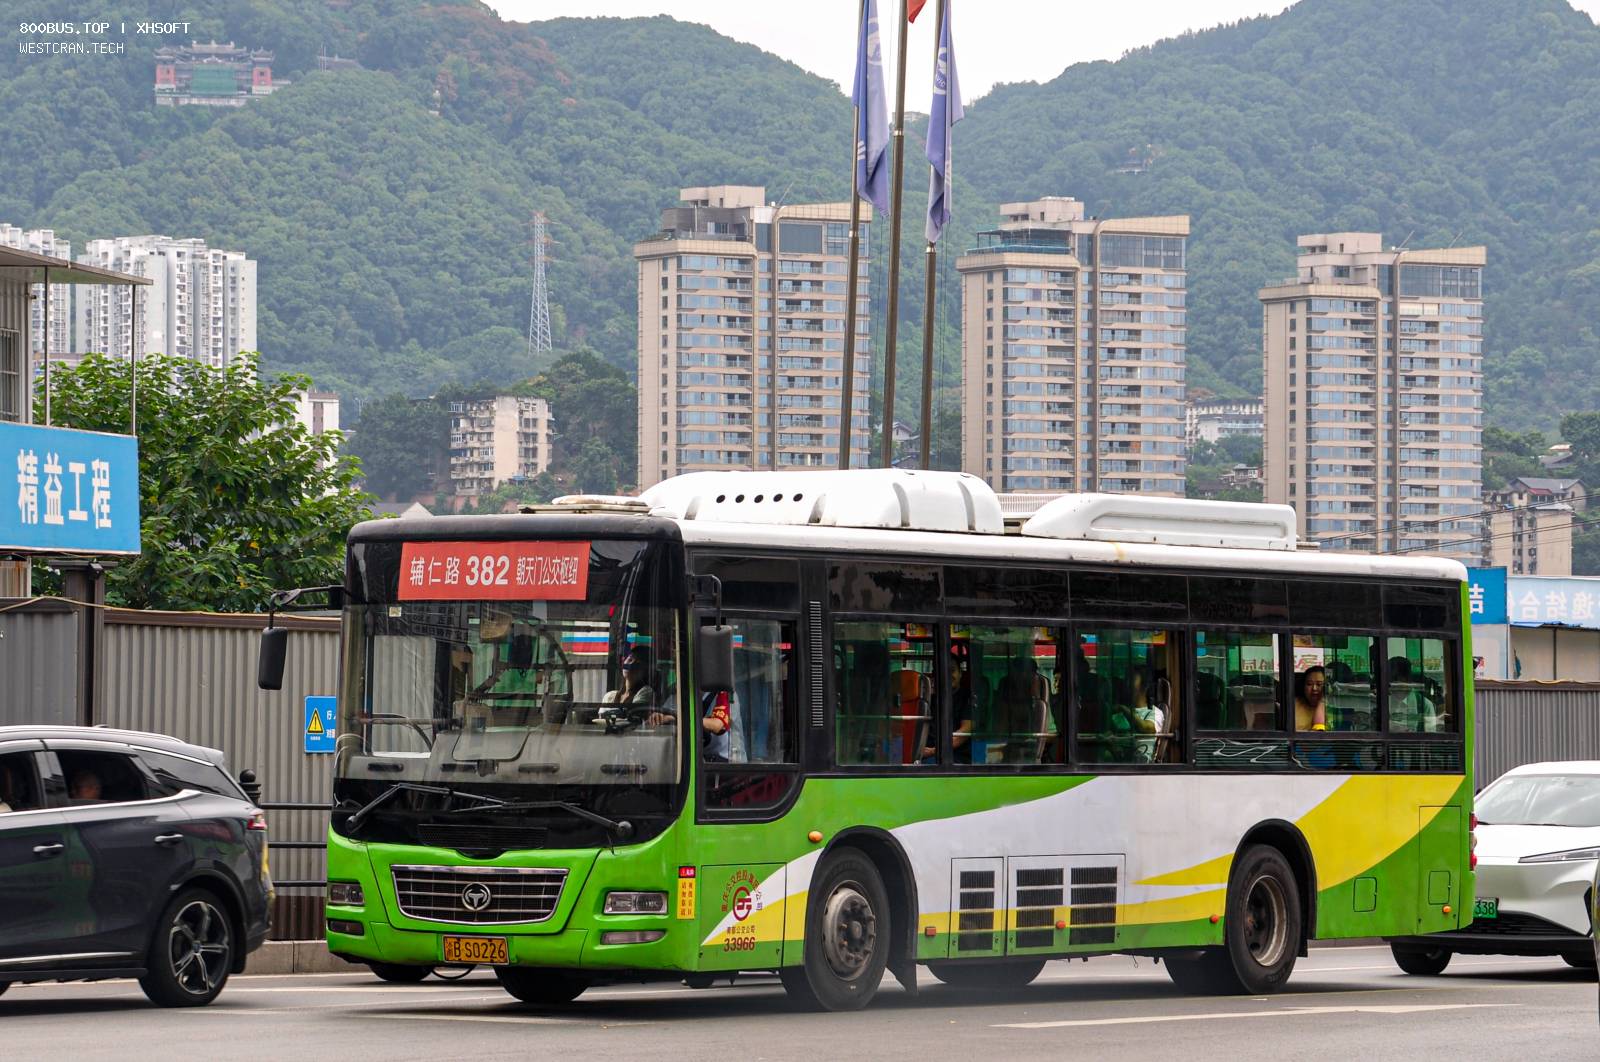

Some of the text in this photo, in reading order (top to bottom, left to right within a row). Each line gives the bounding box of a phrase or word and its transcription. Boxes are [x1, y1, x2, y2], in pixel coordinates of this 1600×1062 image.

[17, 448, 112, 529] 精益工程
[410, 555, 579, 586] 辅仁路 382 朝天门公交枢纽
[723, 937, 756, 953] 33966
